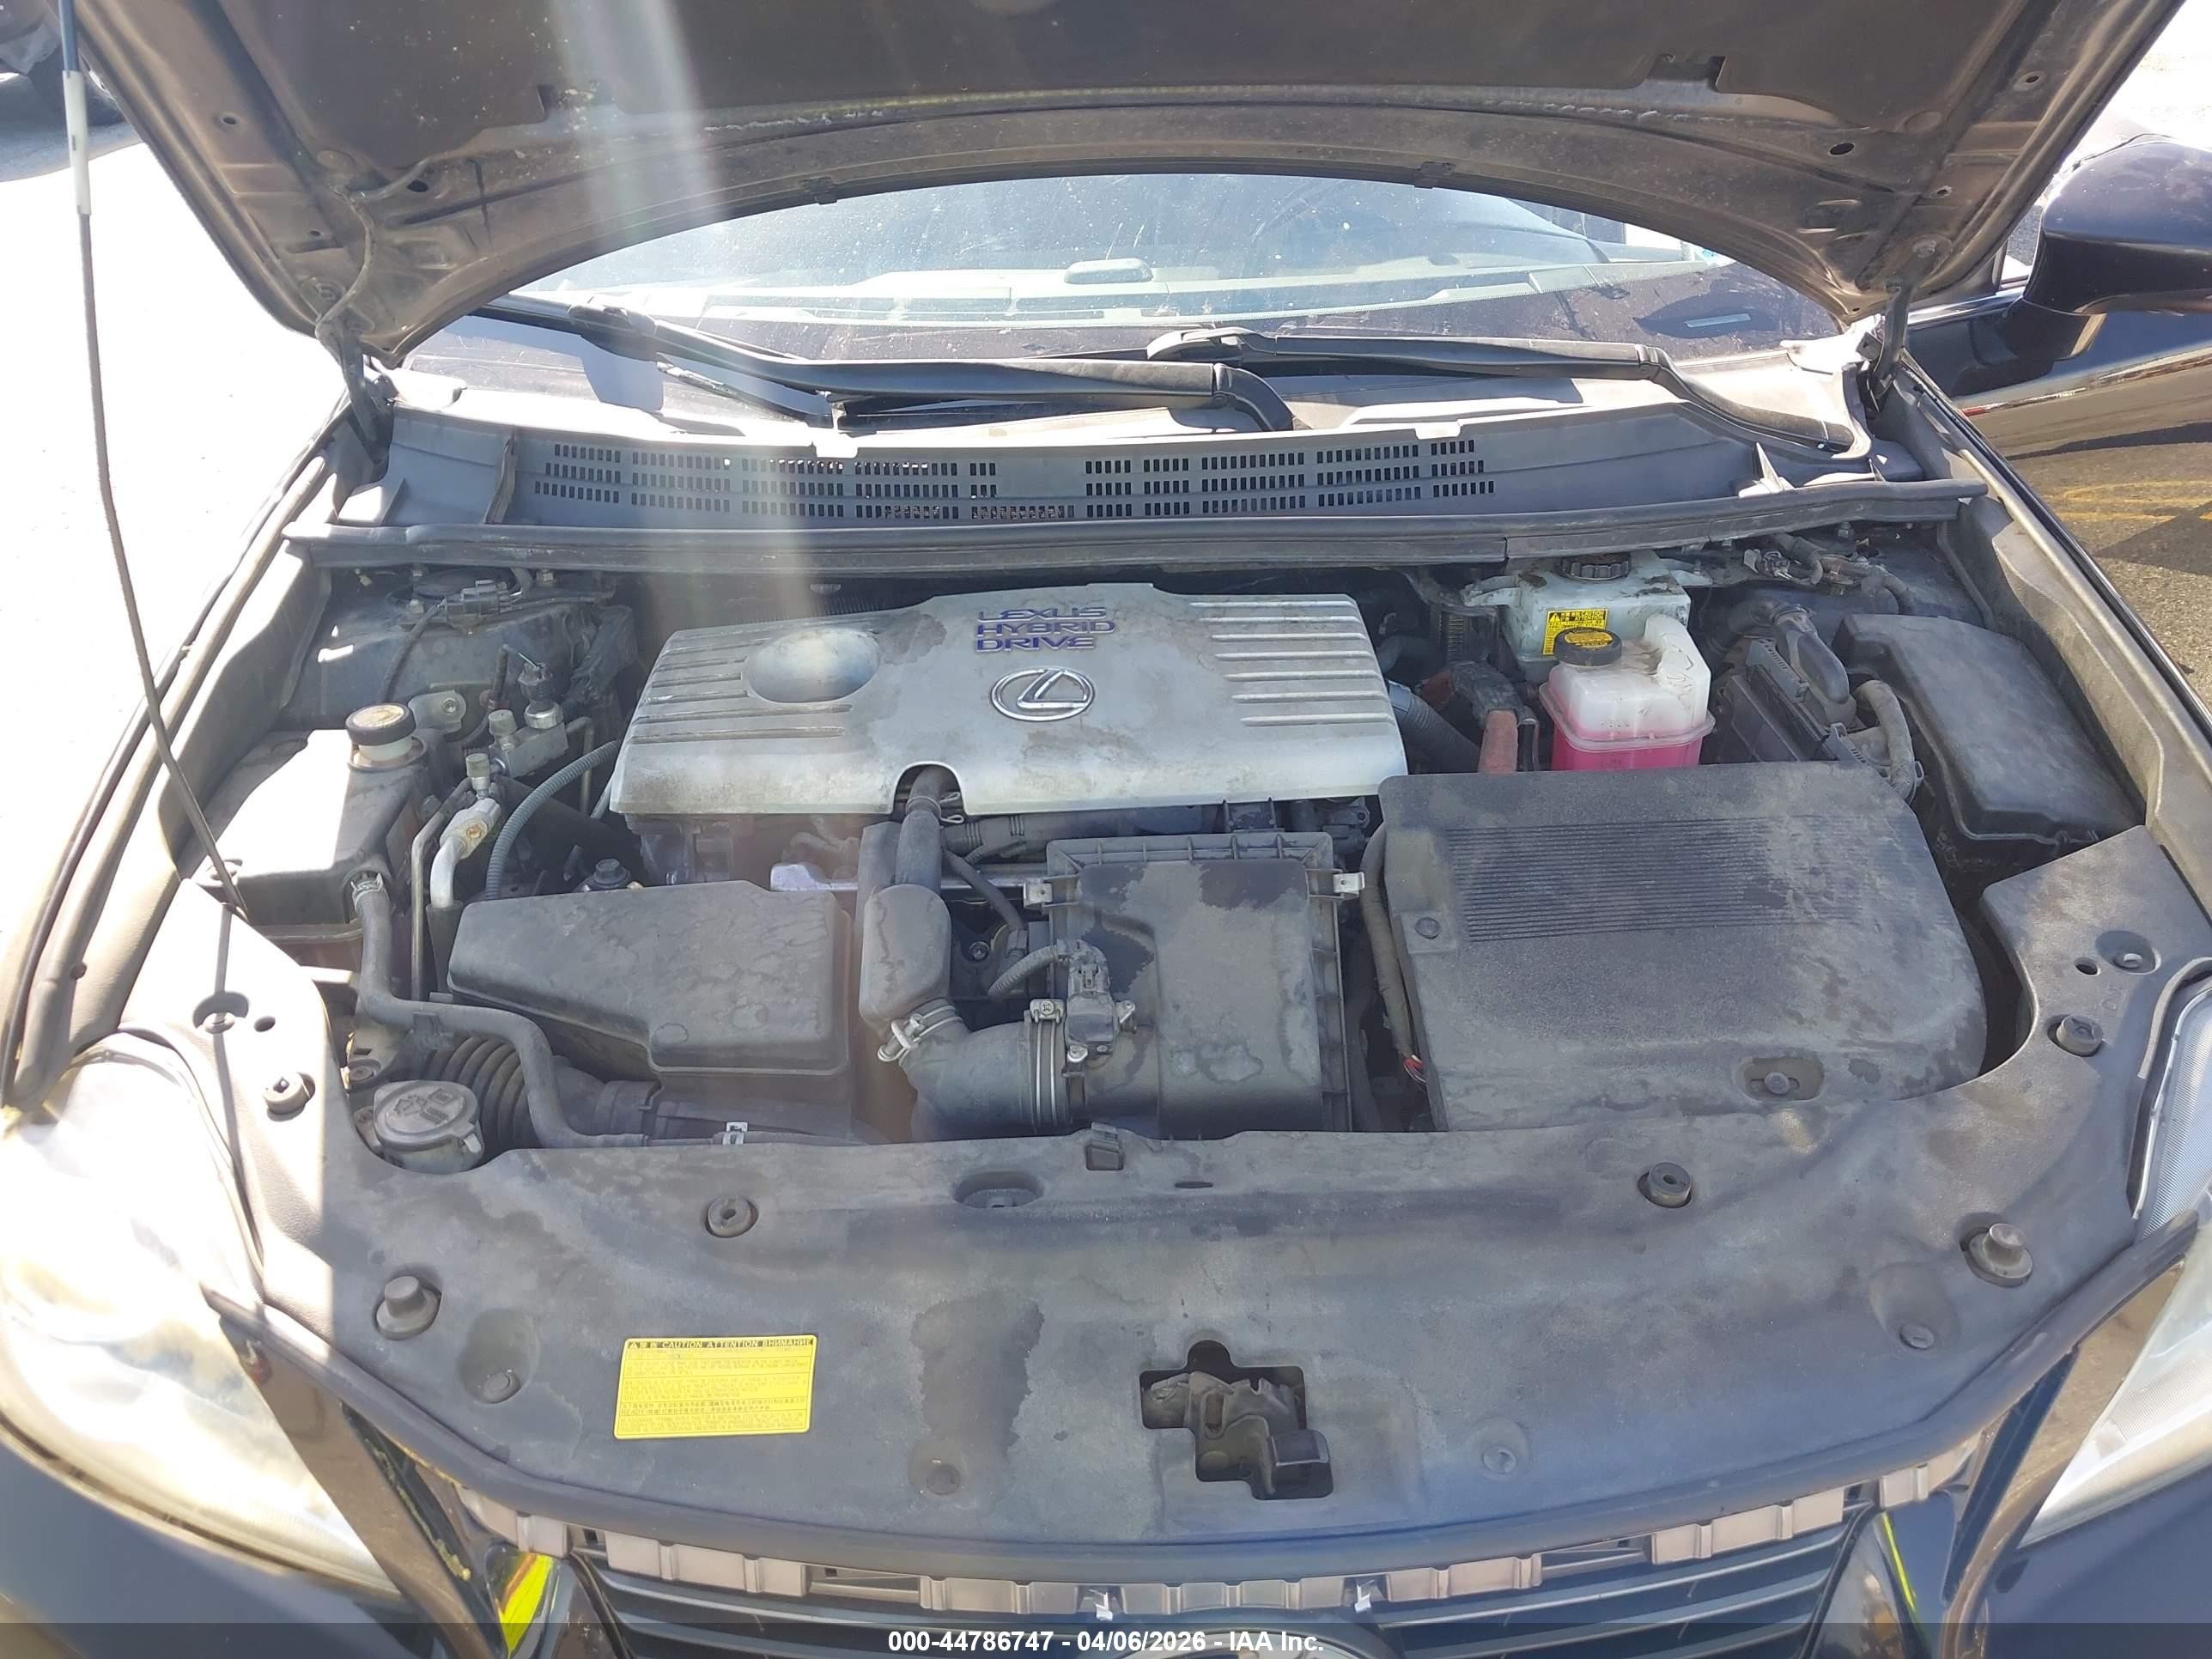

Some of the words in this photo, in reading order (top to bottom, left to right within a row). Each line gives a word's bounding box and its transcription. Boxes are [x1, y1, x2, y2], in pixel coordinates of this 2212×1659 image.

[977, 607, 1107, 623] LEXUS
[977, 622, 1116, 636] HYBRID
[976, 636, 1095, 652] DRIVE
[707, 1340, 758, 1348] ATTENTION
[763, 1338, 812, 1347] ВНИМАНИЕ
